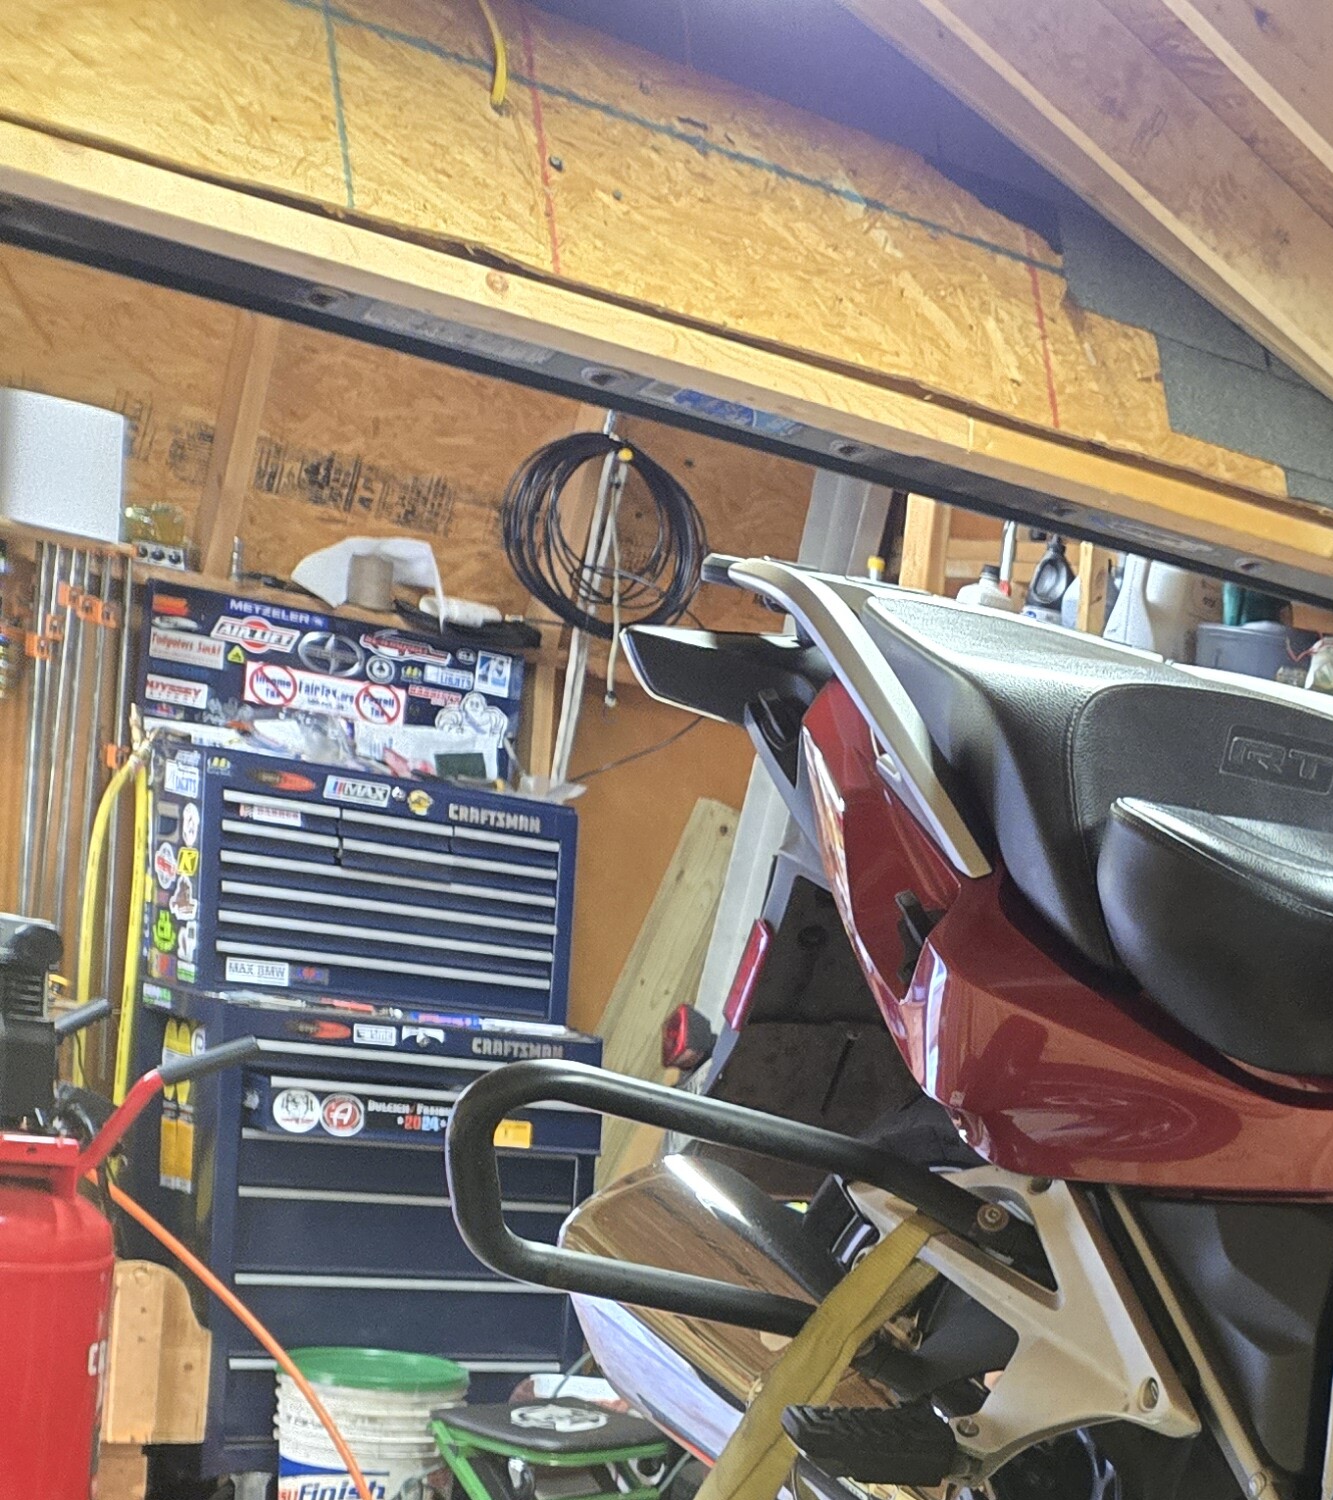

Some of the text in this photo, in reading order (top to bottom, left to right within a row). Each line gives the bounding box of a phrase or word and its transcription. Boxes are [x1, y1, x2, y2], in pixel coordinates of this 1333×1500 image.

[229, 599, 310, 624] METZELER
[220, 622, 294, 647] AIR LIFT
[345, 783, 387, 802] MAX
[449, 803, 541, 833] CRAFTSMAN
[228, 962, 286, 980] MAX BMW
[472, 1037, 563, 1058] CRAFTSMAN
